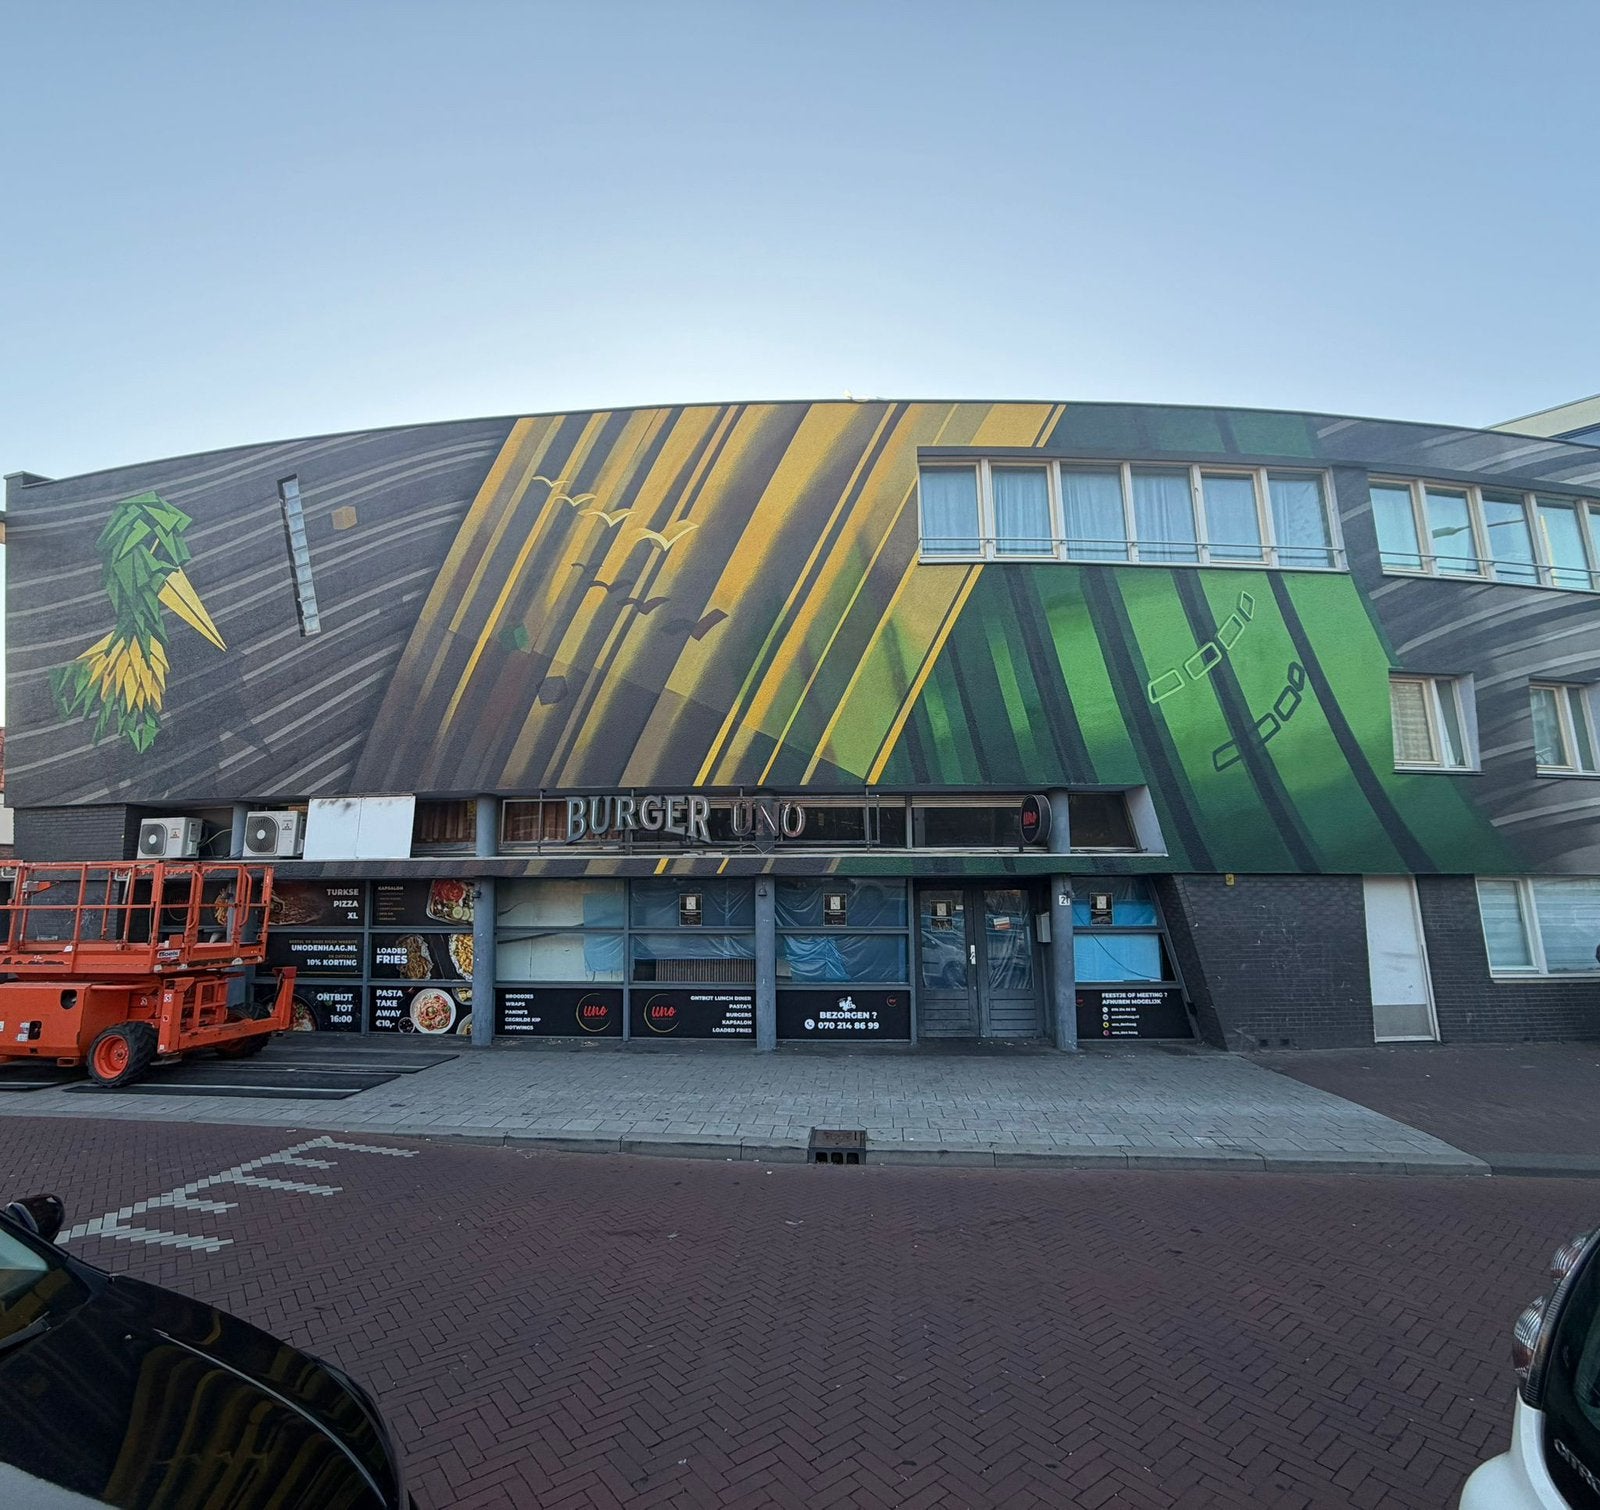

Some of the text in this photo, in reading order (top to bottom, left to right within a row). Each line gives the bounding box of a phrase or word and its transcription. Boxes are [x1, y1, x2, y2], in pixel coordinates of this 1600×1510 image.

[564, 795, 806, 844] BURGER UNO
[326, 888, 359, 896] TURKSE
[291, 944, 357, 952] UNODENHAAG.NL
[376, 955, 408, 964] FRIES
[316, 993, 353, 1001] ONTBIJT
[335, 1004, 353, 1012] TOT
[330, 1015, 353, 1023] 16:00
[819, 1011, 878, 1019] BEZORGEN ?
[376, 1020, 395, 1028] €10,-
[818, 1021, 880, 1029] 070 214 86 99
